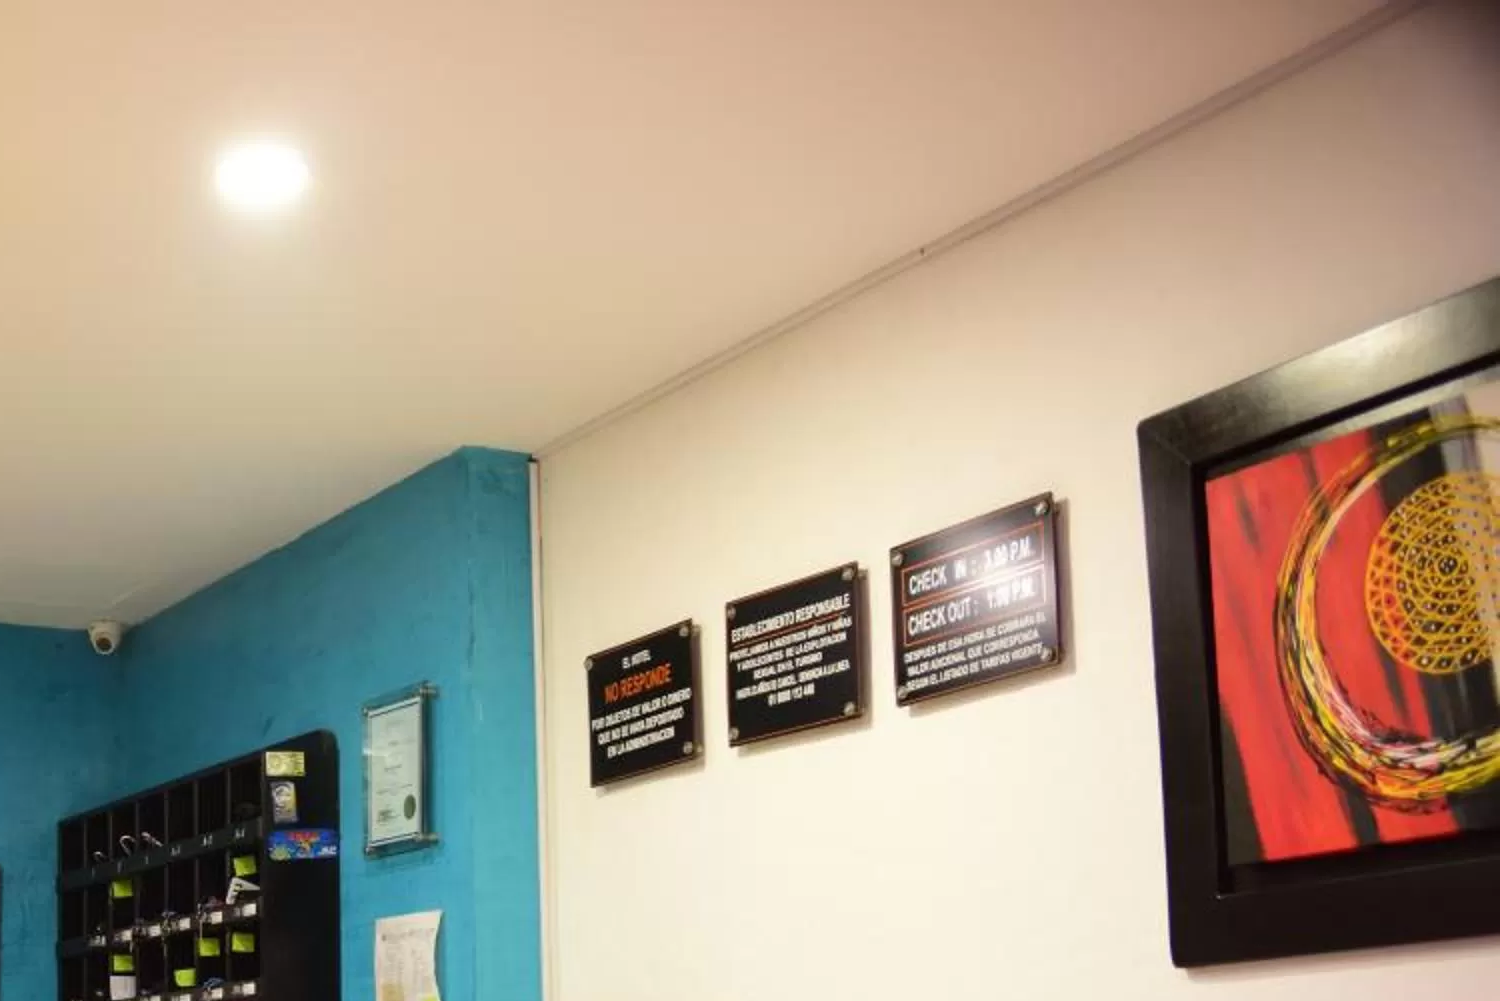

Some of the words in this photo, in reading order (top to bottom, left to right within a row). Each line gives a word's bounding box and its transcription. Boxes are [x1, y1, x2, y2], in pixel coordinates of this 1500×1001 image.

[909, 564, 947, 595] CHECK
[954, 558, 966, 580] IN
[731, 611, 795, 643] ESTABLECIMIENTO
[796, 593, 850, 623] RESPONSABLE
[908, 604, 947, 636] CHECK
[947, 595, 971, 623] OUT
[604, 682, 619, 704] NO
[620, 662, 673, 698] RESPONDE
